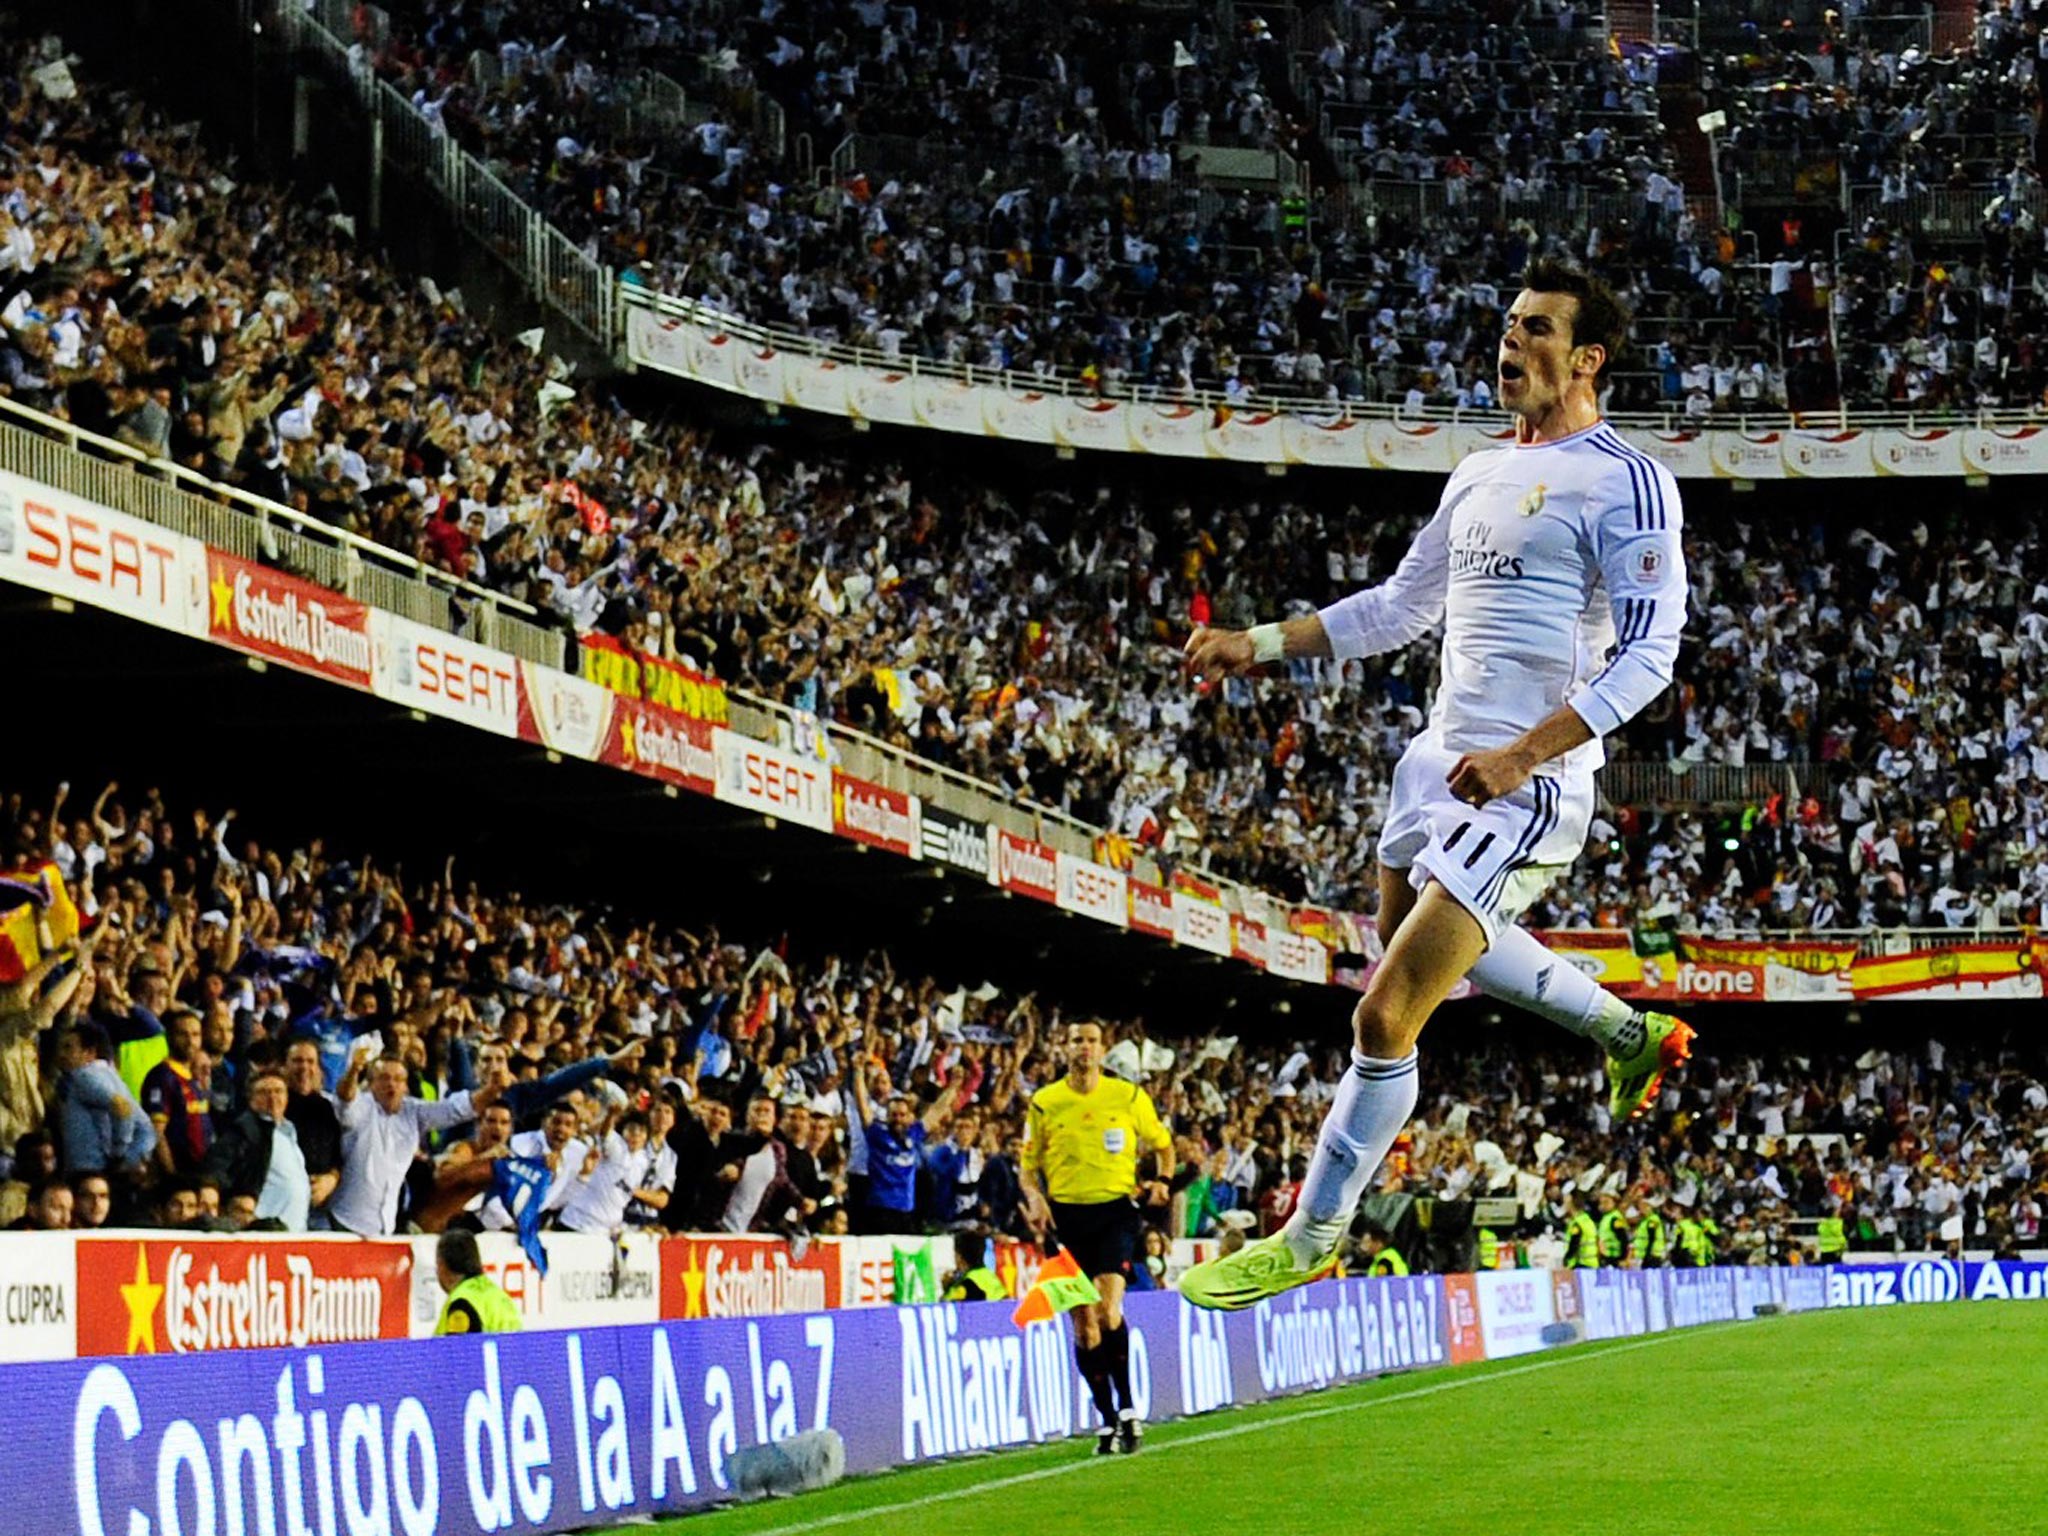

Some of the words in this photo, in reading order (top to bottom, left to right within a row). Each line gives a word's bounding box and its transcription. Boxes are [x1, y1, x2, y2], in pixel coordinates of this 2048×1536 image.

[25, 500, 175, 606] SEAT
[234, 568, 311, 654] Estrella
[308, 599, 370, 672] Damm
[417, 645, 512, 716] SEAT
[746, 753, 816, 812] SEAT
[1443, 821, 1497, 870] 11
[1677, 962, 1754, 993] fone
[6, 1284, 66, 1325] CUPRA
[165, 1246, 287, 1354] Estrella
[286, 1253, 382, 1348] Damm
[706, 1243, 774, 1319] Estrella
[772, 1250, 825, 1315] Damm
[861, 1261, 893, 1301] SE
[1254, 1285, 1337, 1391] Contigo
[1335, 1283, 1363, 1376] de
[1358, 1280, 1383, 1371] la
[1380, 1279, 1400, 1368] A
[898, 1302, 1029, 1461] Allianz
[75, 1354, 440, 1536] Contigo
[464, 1340, 552, 1533] de
[566, 1333, 635, 1512] la
[652, 1327, 697, 1499] A
[704, 1364, 738, 1491] a
[747, 1321, 798, 1444] la
